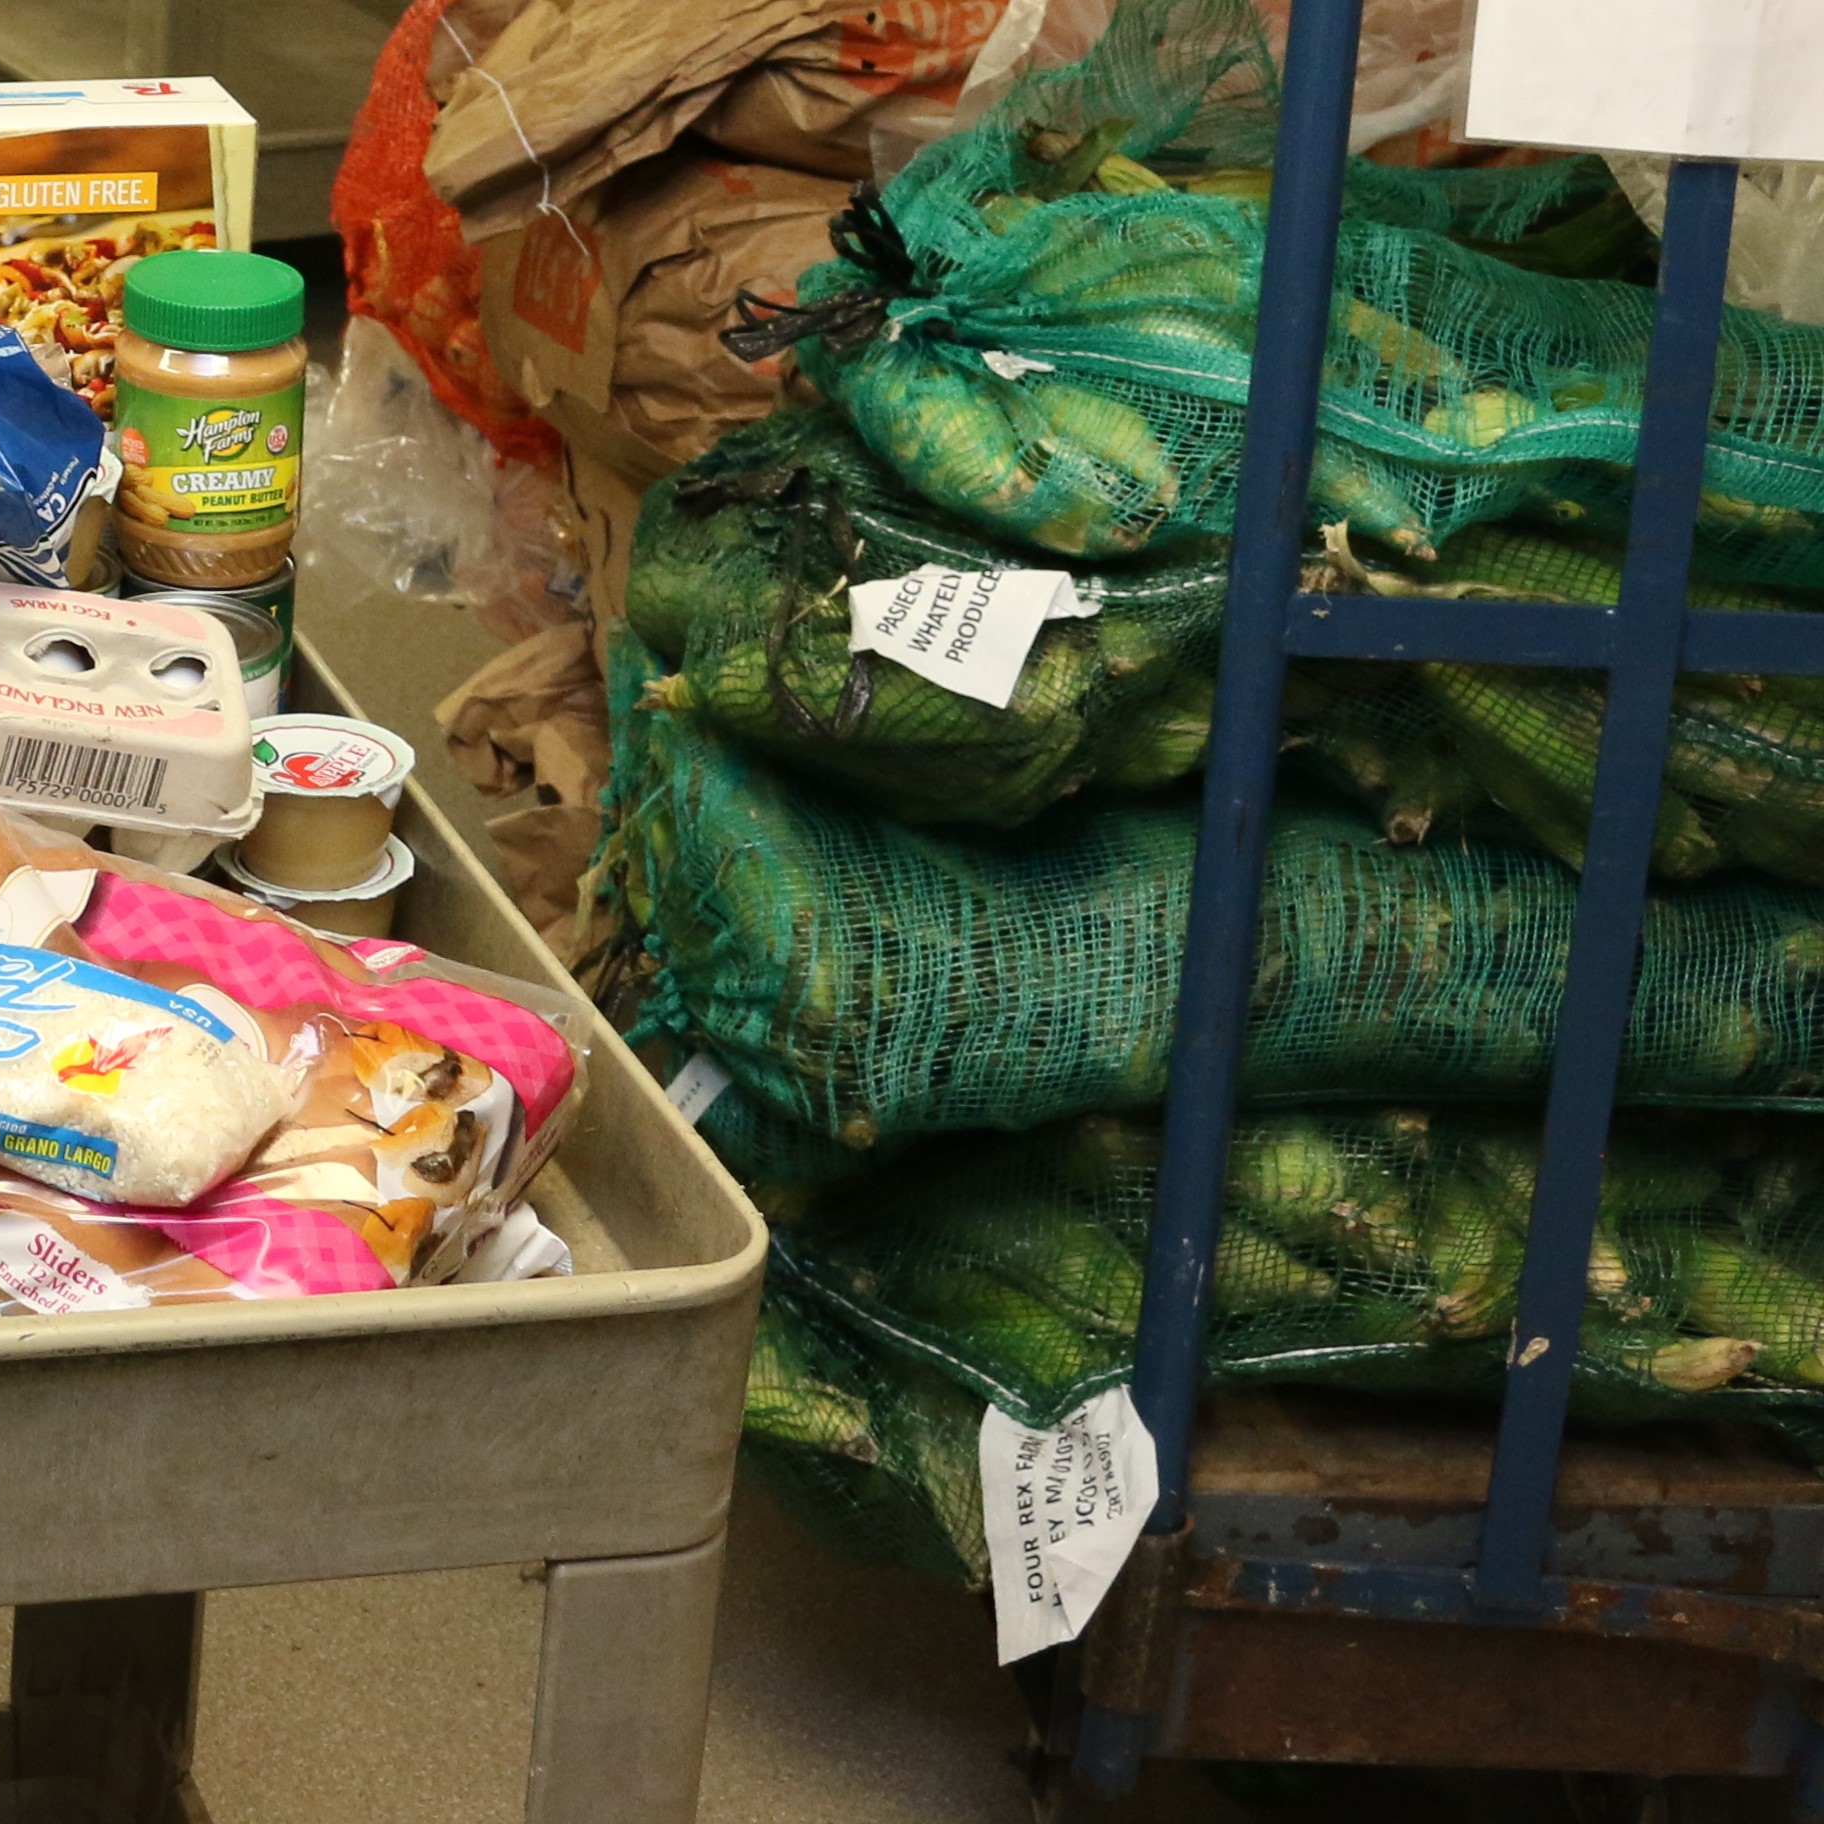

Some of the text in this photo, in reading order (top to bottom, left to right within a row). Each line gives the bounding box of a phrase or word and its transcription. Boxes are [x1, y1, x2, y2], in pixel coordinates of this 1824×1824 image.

[89, 178, 149, 207] FREE.
[176, 409, 261, 451] Hampton
[204, 427, 256, 465] Farms
[171, 467, 277, 495] CREAMY
[201, 488, 284, 508] PEANUT BUTTER
[9, 596, 112, 623] EGG FARMS
[944, 567, 1003, 665] PRODUCE
[115, 702, 166, 720] NEW
[309, 744, 371, 787] APPLE
[16, 776, 74, 803] 75729
[155, 801, 168, 817] 5
[169, 1000, 214, 1030] USA
[3, 1131, 60, 1159] GRANO
[63, 1145, 112, 1175] LARGO
[27, 1264, 86, 1305] 12 Mini
[28, 1233, 109, 1296] Sliders
[1017, 1480, 1034, 1527] REX
[1023, 1535, 1044, 1604] FOUR
